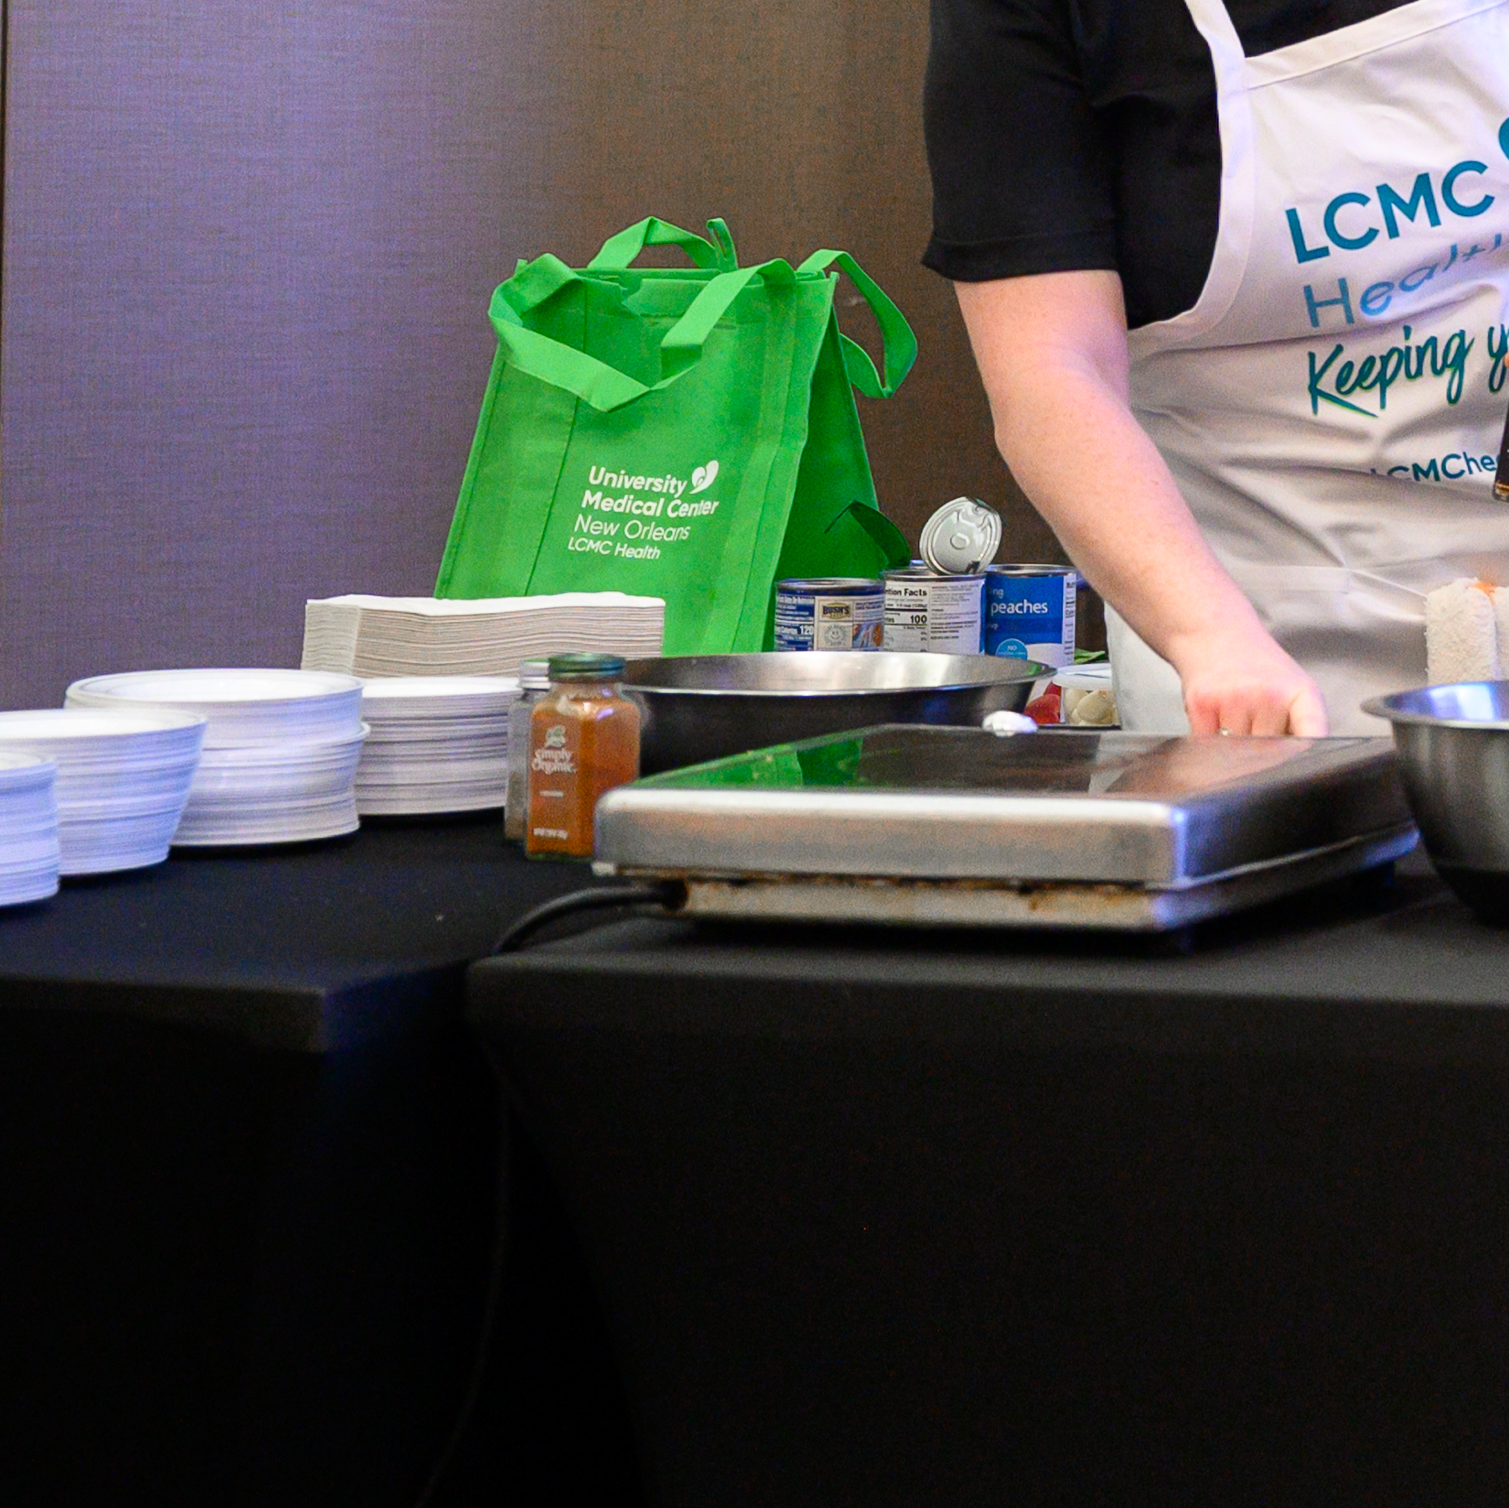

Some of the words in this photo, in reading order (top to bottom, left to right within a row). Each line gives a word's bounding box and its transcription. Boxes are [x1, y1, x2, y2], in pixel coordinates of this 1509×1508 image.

[1286, 159, 1495, 265] LCMC
[1308, 324, 1476, 419] Keeping
[588, 465, 688, 498] University
[581, 489, 665, 517] Medical
[667, 498, 720, 519] Center
[574, 513, 620, 537] New
[624, 519, 692, 542] Orleans
[568, 536, 613, 555] LCMC
[614, 542, 661, 560] Health
[904, 588, 928, 597] Facts
[910, 614, 928, 624] 100
[991, 598, 1049, 617] peaches
